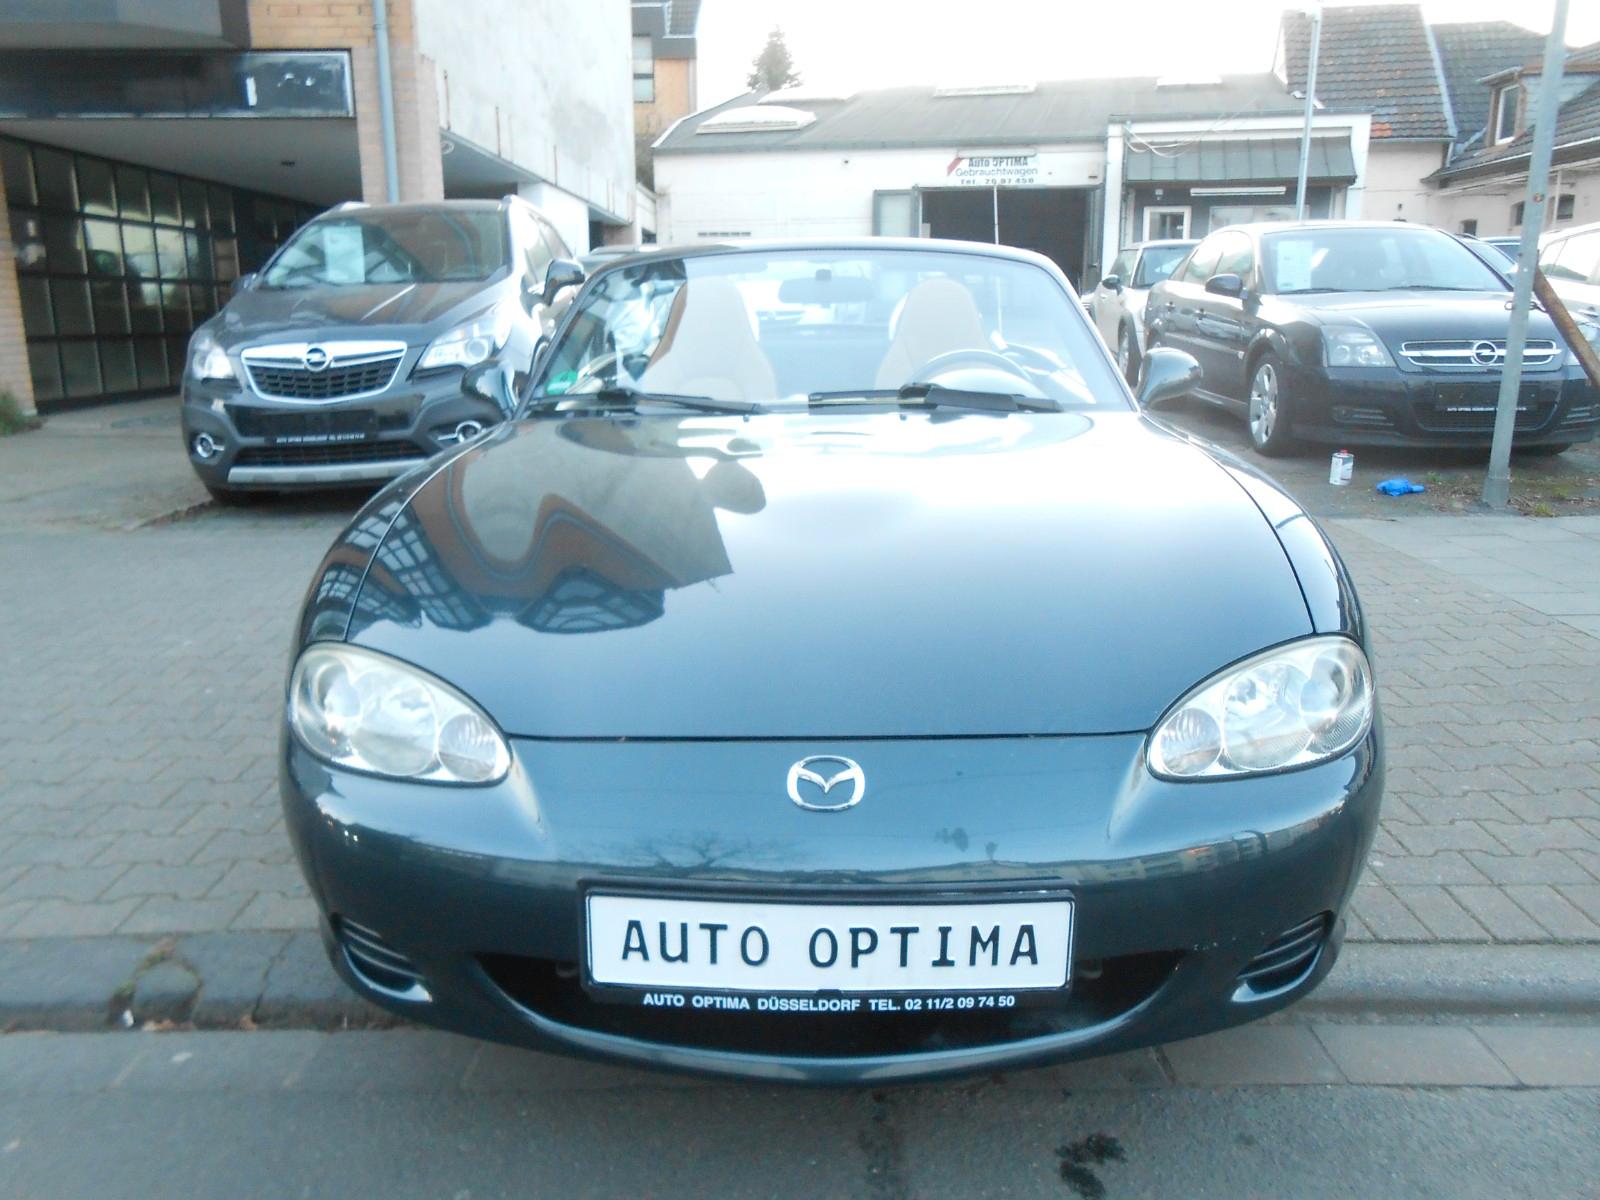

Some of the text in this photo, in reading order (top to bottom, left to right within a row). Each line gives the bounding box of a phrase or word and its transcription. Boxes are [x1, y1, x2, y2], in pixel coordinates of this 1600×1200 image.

[955, 167, 1038, 177] Gebrauchtwagen
[622, 920, 1038, 968] AUTO OPTIMA
[643, 994, 684, 1007] AUTO
[692, 995, 749, 1010] OPTIMA
[757, 996, 860, 1011] DÜSSELDORF
[869, 999, 900, 1011] TEL.
[904, 998, 922, 1010] 02
[957, 997, 974, 1008] 09
[978, 996, 994, 1007] 74
[998, 995, 1015, 1007] 50
